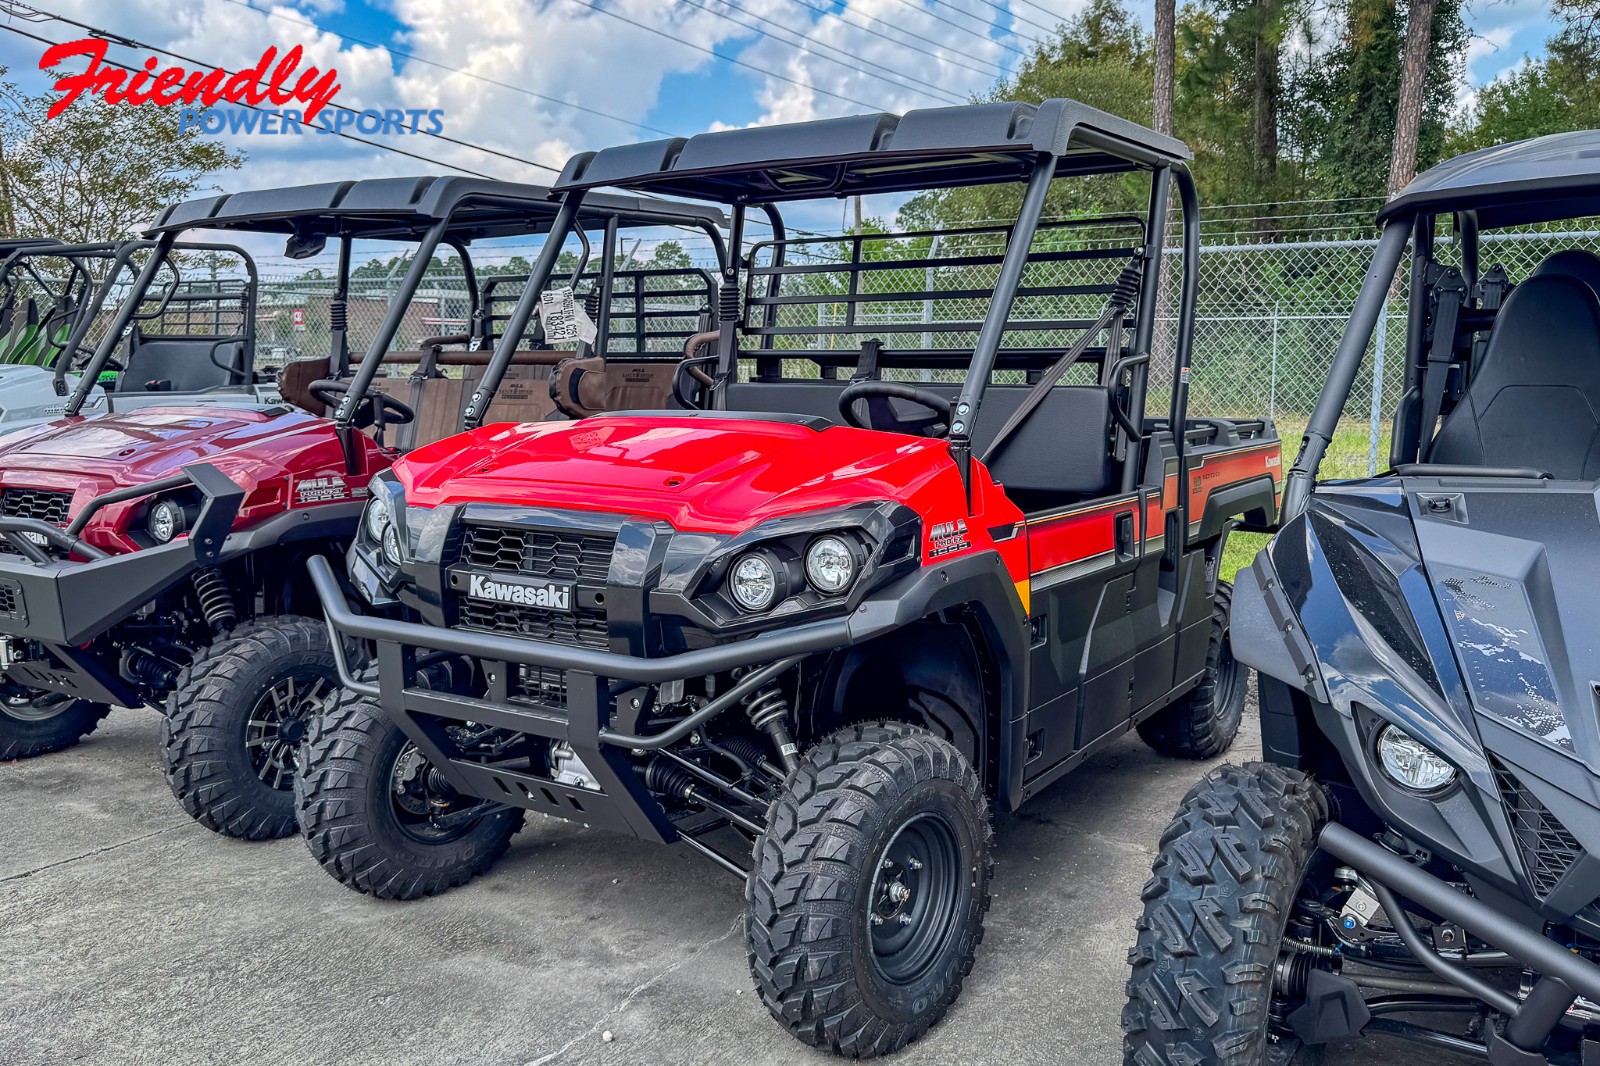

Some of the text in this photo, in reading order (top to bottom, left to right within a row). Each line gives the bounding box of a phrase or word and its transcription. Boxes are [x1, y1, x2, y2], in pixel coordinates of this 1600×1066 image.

[550, 310, 567, 341] T83421
[296, 477, 347, 492] MULE
[929, 519, 969, 541] MULE
[470, 574, 569, 609] Kawasaki
